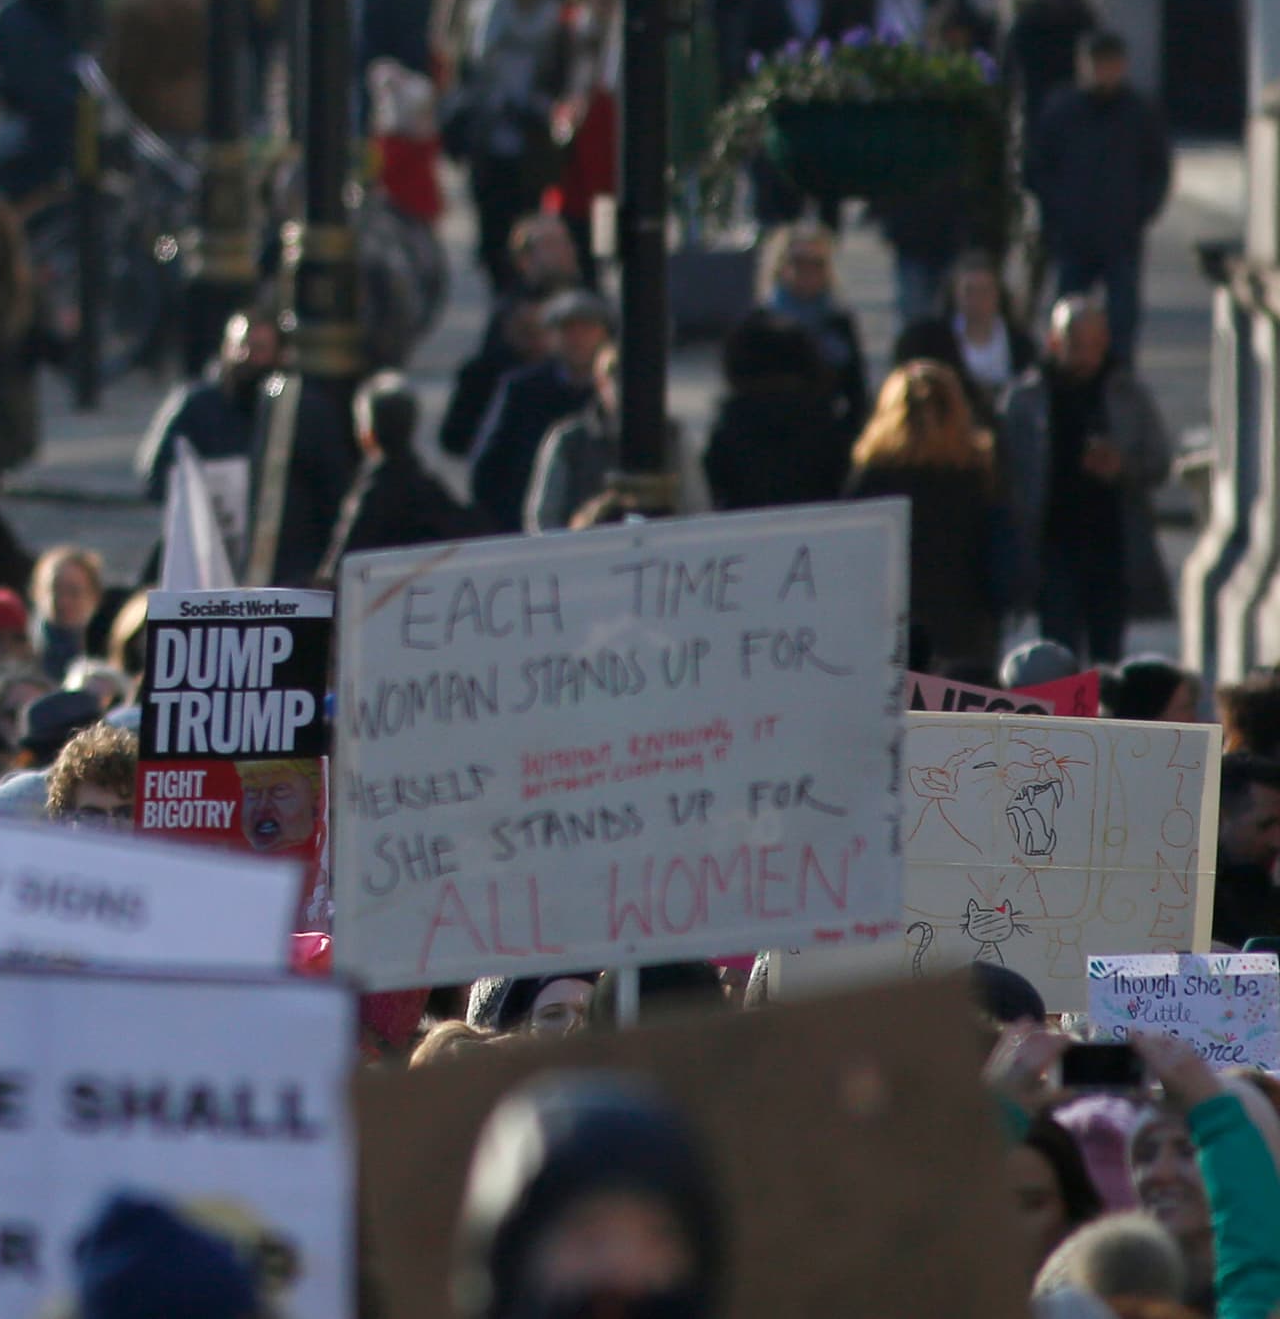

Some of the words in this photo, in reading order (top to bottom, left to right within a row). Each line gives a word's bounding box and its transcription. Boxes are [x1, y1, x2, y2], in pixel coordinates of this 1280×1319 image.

[179, 600, 244, 618] Socialist
[245, 600, 299, 618] Worker
[401, 570, 563, 651] EACH
[610, 552, 745, 619] TIME
[777, 543, 817, 603] A
[153, 626, 294, 690] DUMP
[351, 663, 500, 741] WOMAN
[511, 644, 646, 715] STANDS
[662, 635, 711, 689] UP
[741, 625, 854, 683] FOR
[150, 689, 316, 754] TRUMP
[143, 801, 237, 829] BIGOTRY
[144, 770, 208, 799] FIGHT
[347, 761, 494, 821] HERSELF
[364, 831, 462, 898] SHE
[490, 803, 643, 863] STANDS
[668, 787, 716, 828] UP
[748, 774, 848, 819] FOR
[416, 873, 567, 978] ALL
[1104, 966, 1176, 999] Though
[1234, 975, 1261, 997] be
[62, 1073, 322, 1142] SHALL
